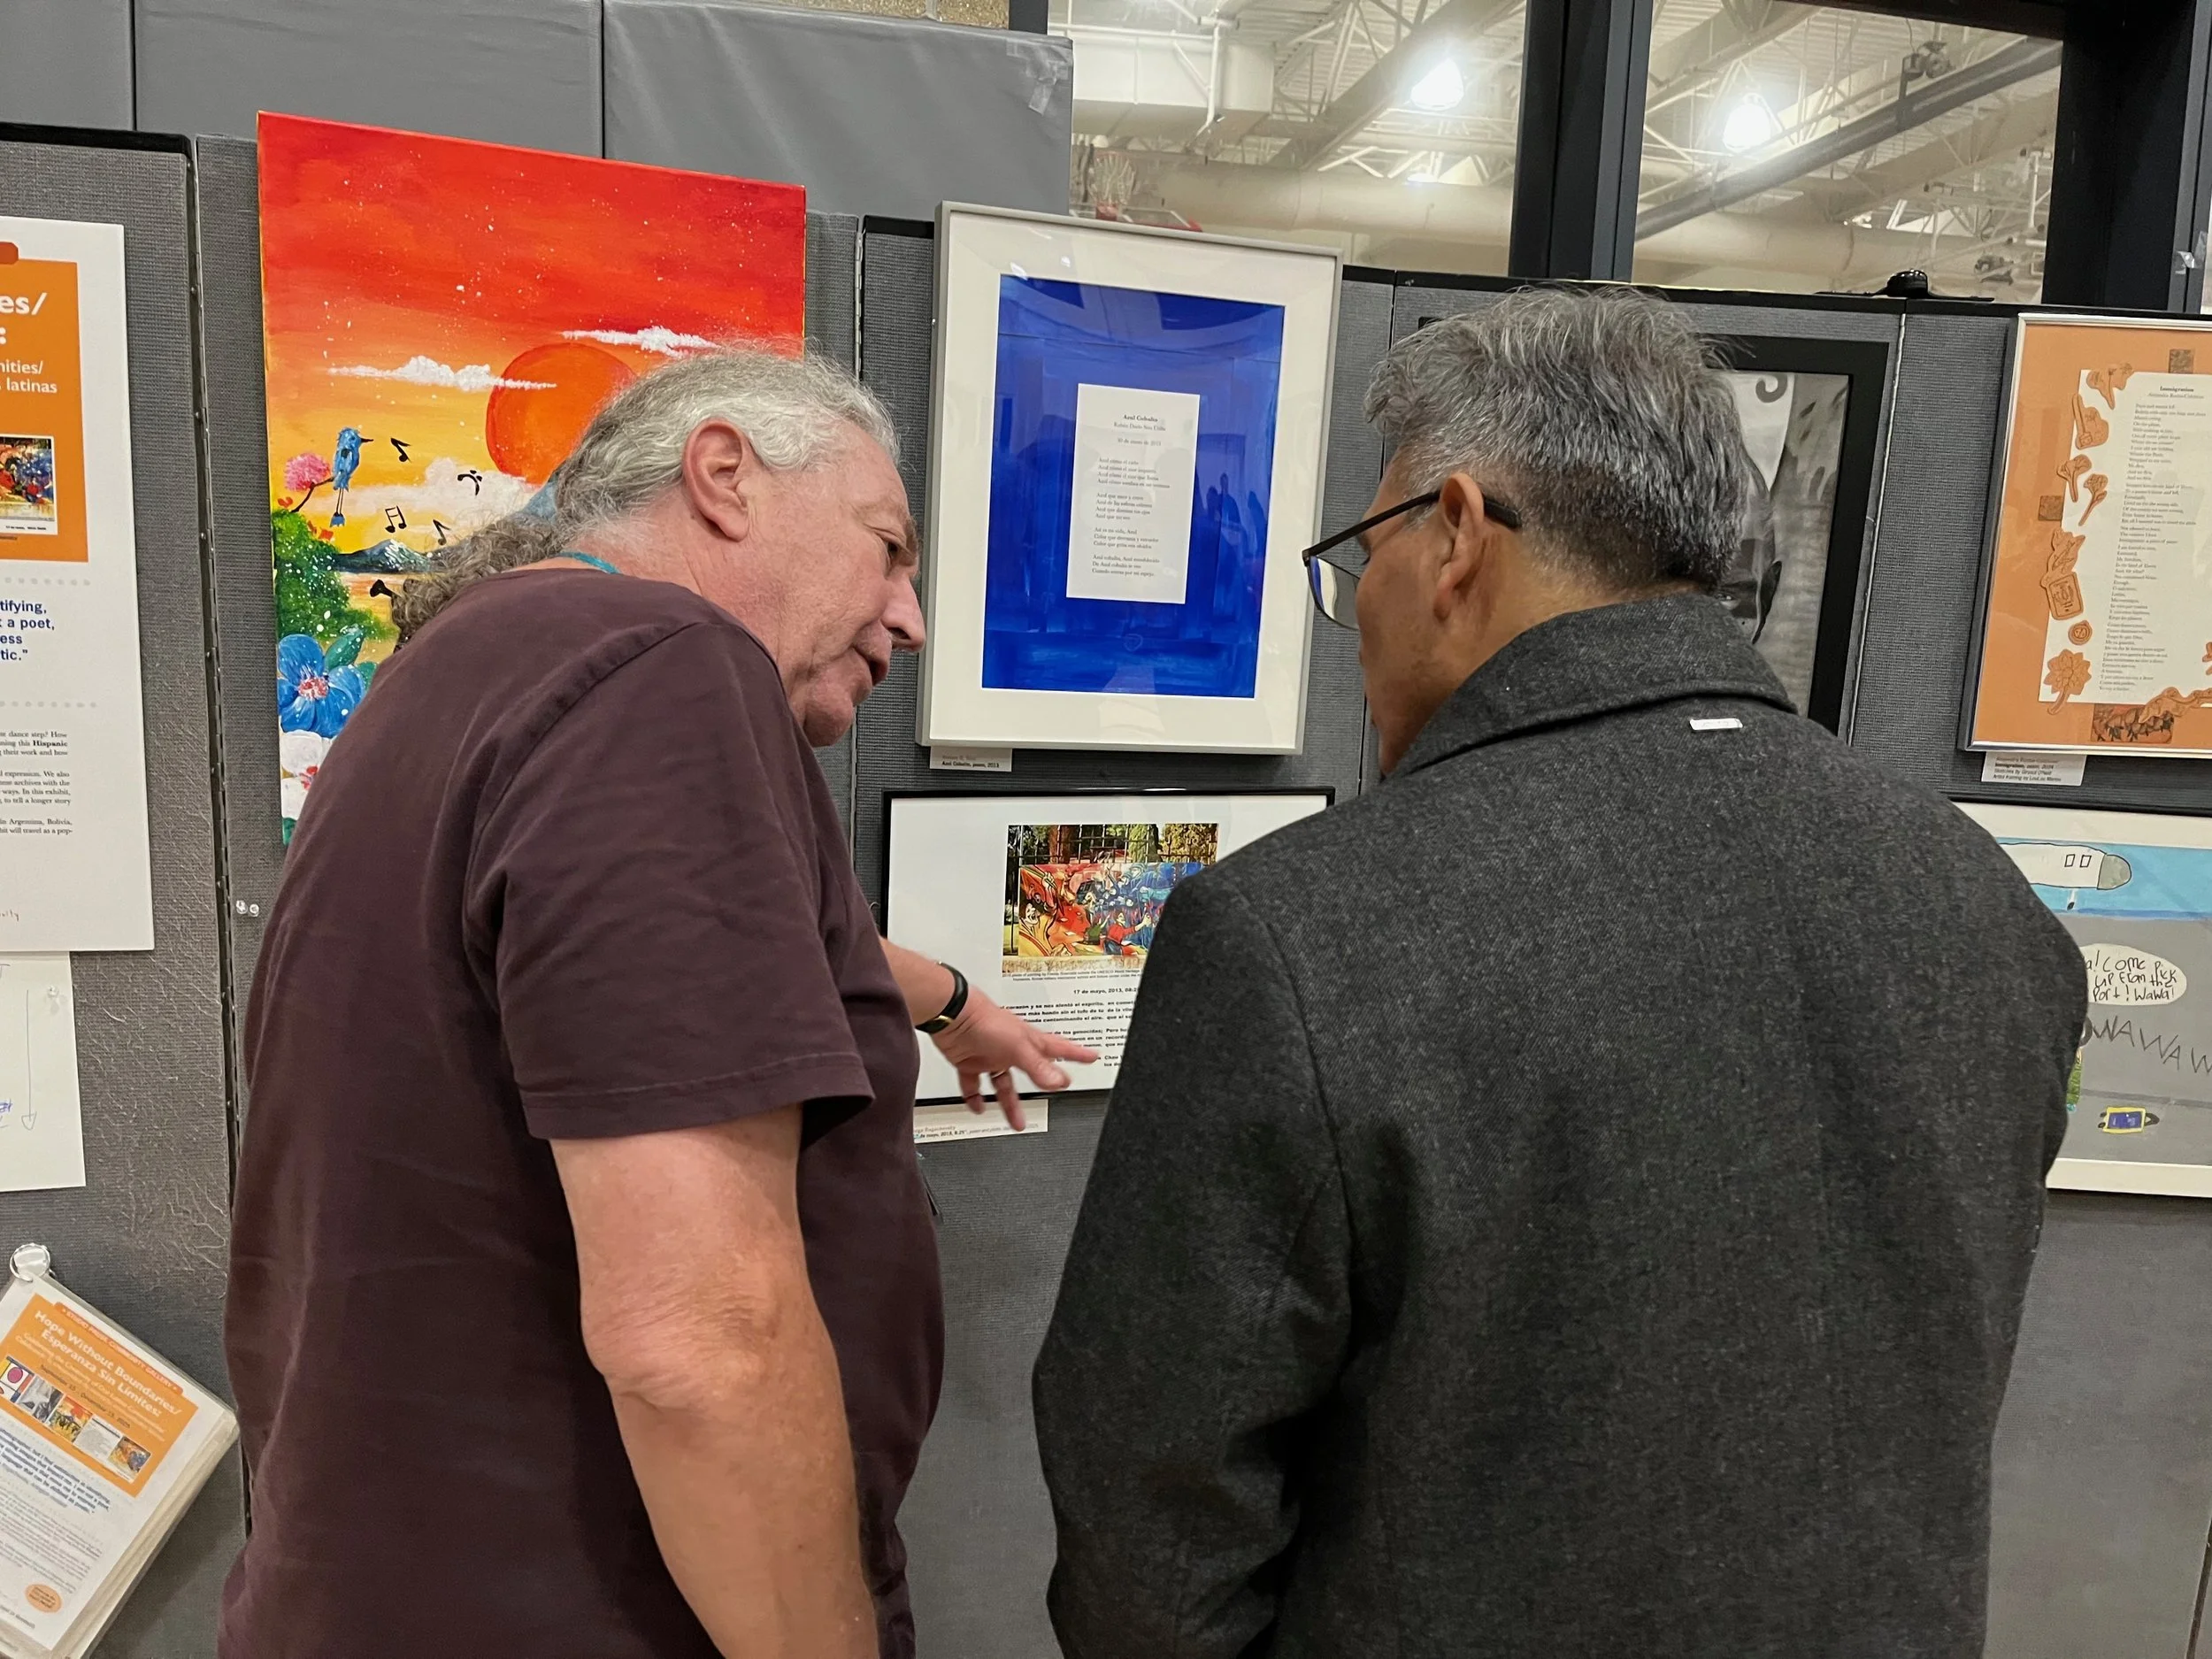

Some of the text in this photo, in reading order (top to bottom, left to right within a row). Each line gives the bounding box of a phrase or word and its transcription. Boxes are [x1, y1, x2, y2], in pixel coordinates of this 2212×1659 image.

[0, 292, 47, 315] es/
[7, 376, 58, 393] latinas
[8, 618, 55, 630] a poet,
[0, 635, 23, 644] ess
[34, 1310, 65, 1332] Hope
[69, 1333, 114, 1370] Without
[118, 1366, 182, 1415] Boundaries/
[41, 1330, 96, 1372] Esperanza
[99, 1365, 116, 1385] Sin
